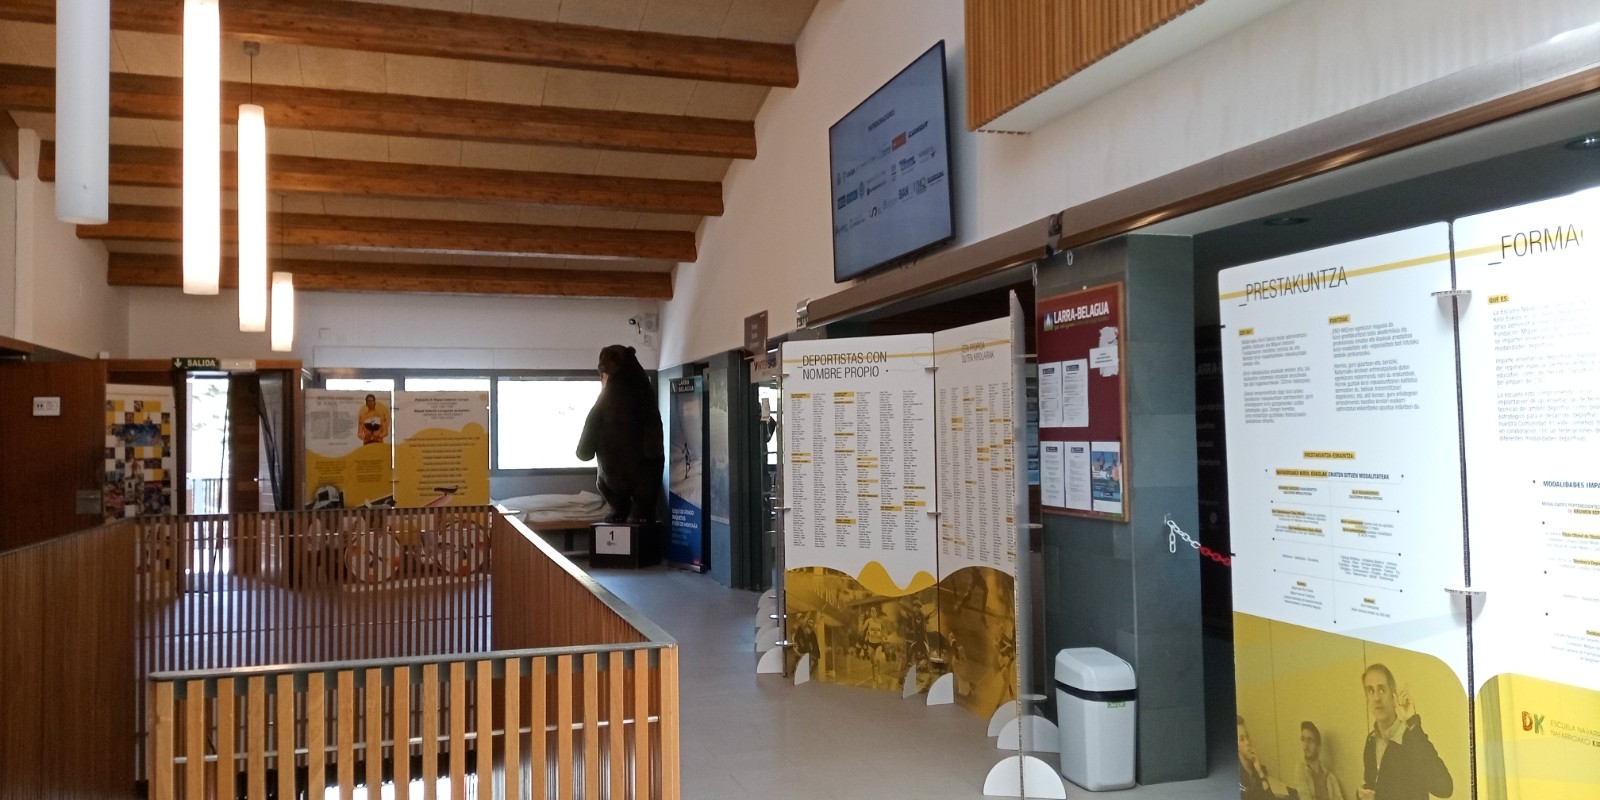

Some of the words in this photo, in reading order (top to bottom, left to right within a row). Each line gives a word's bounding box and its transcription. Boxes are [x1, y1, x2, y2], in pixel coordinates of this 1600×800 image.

[1053, 301, 1110, 324] LARRA-BELAGUA
[187, 359, 216, 367] SALIDA
[866, 351, 887, 364] CON
[803, 368, 842, 380] NOMBRE
[845, 365, 880, 378] PROPIO
[609, 530, 614, 541] 1
[1522, 711, 1545, 735] DK
[1550, 720, 1576, 731] ESCUELA
